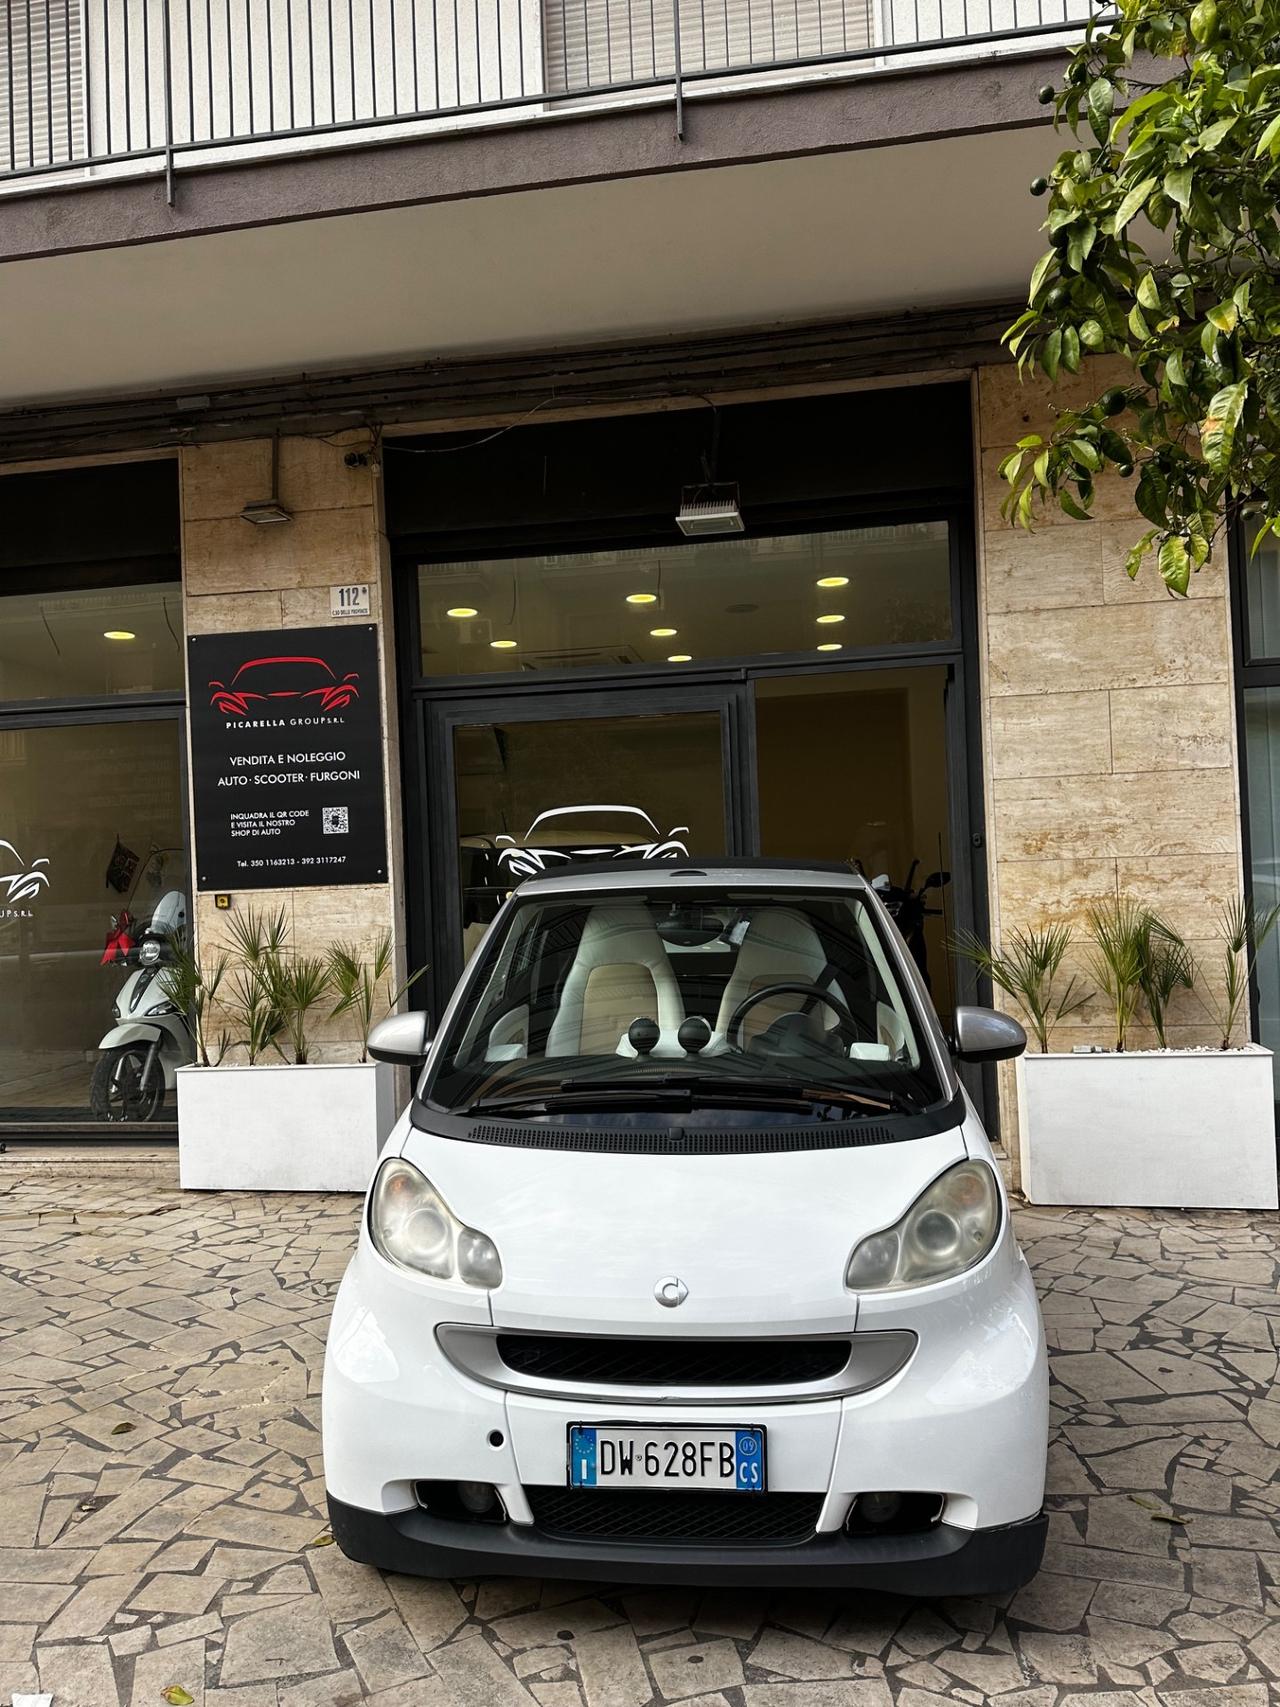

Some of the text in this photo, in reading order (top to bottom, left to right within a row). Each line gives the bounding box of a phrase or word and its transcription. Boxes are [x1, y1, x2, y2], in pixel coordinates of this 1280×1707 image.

[339, 587, 360, 606] 112
[226, 719, 285, 729] PICARELLA
[289, 717, 326, 726] GROUP
[229, 751, 346, 766] VENDITA E NOLEGGIO
[310, 770, 360, 782] FURGONI
[230, 809, 310, 820] INQUADRA IL QR CODE
[230, 821, 236, 829] E
[258, 820, 265, 828] IL
[266, 819, 296, 827] NOSTRO
[231, 829, 250, 837] SHOP
[260, 828, 281, 836] AUTO
[250, 859, 264, 867] 350
[739, 1462, 758, 1483] CS
